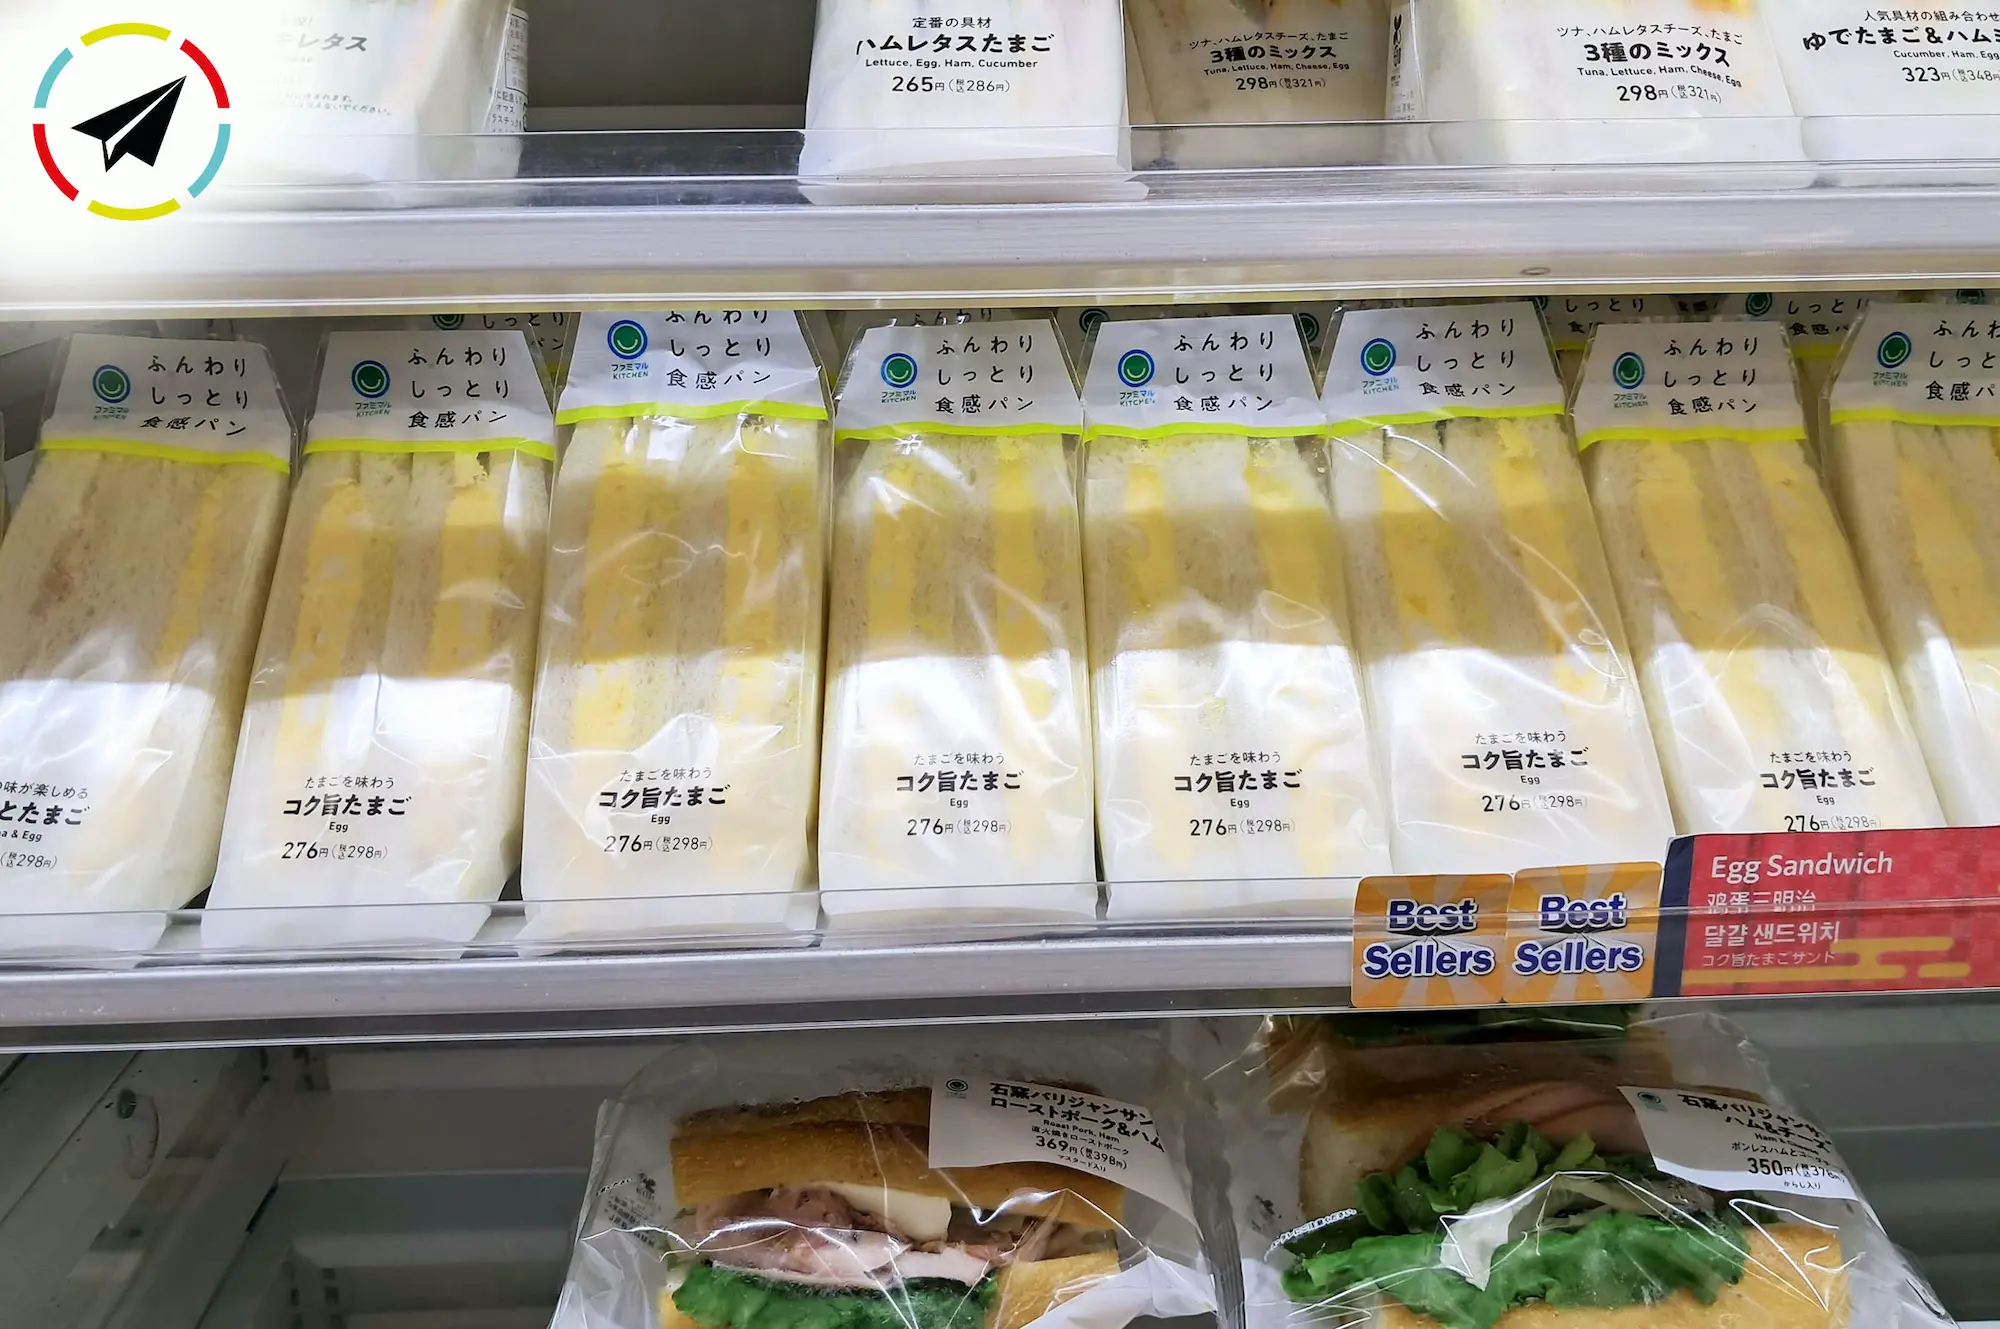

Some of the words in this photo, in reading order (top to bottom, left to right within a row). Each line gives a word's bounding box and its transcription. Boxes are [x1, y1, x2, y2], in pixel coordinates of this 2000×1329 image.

[912, 17, 992, 28] 定番の具材
[1189, 32, 1349, 50] ツナ、ハムレタスチーズ、たまご
[1556, 23, 1744, 45] ツナ、ハムレタスチーズ、たまご
[855, 33, 1055, 55] ハムレタスたまご
[865, 59, 912, 68] Lettuce,
[916, 59, 941, 69] Egg,
[945, 59, 974, 68] Ham,
[978, 59, 1038, 68] Cucumber
[1211, 45, 1337, 64] 3種のミックス
[1583, 41, 1730, 68] 3種のミックス
[1893, 50, 1950, 59] Cucumber,
[1952, 50, 1978, 59] Ham,
[1204, 68, 1230, 76] Tuna,
[1231, 63, 1268, 72] Lettuce,
[1270, 62, 1294, 71] Ham,
[1333, 62, 1350, 70] Egg
[1577, 67, 1608, 77] Tuna,
[1610, 67, 1656, 76] Lettuce,
[1659, 65, 1688, 74] Ham,
[1690, 65, 1724, 83] Cheese,
[1725, 75, 1742, 88] Egg
[1566, 298, 1644, 313] しっとり
[665, 310, 769, 324] ふんわり
[1416, 318, 1514, 340] ふんわり
[670, 337, 771, 357] しっとり
[936, 335, 1033, 355] ふんわり
[1173, 331, 1274, 351] ふんわり
[1664, 337, 1758, 356] ふんわり
[408, 347, 506, 366] ふんわり
[1417, 351, 1514, 372] しっとり
[1929, 351, 1996, 369] しっと
[148, 356, 245, 377] ふんわり
[611, 363, 649, 371] ファミマル
[613, 371, 649, 381] KITCHEN
[938, 365, 1033, 385] しっとり
[1176, 363, 1274, 384] しっとり
[666, 368, 771, 389] 食感パン
[1664, 369, 1756, 387] しっとり
[151, 387, 248, 409] しっとり
[412, 380, 509, 399] しっとり
[1119, 390, 1155, 399] ファミマル
[1419, 382, 1516, 398] 食感パン
[1926, 380, 1995, 401] 食感パ
[881, 396, 917, 404] KITCHEN
[935, 394, 1034, 414] 食感パン
[1173, 395, 1273, 412] 食感パン
[1668, 396, 1757, 415] 食感パン
[140, 416, 247, 436] 食感パン
[408, 411, 507, 428] 食感パン
[1475, 730, 1566, 745] たまごを味わう
[913, 752, 1005, 766] たまごを味わう
[1190, 751, 1281, 766] たまごを味わう
[1461, 746, 1589, 771] コク旨たまご
[1770, 750, 1852, 764] たまごを味わう
[304, 775, 395, 789] たまごを味わう
[619, 767, 712, 782] たまごを味わう
[896, 770, 1025, 792] コク旨たまご
[1174, 768, 1303, 793] コク旨たまご
[1520, 775, 1541, 785] Egg
[1760, 766, 1876, 790] コク旨たまご
[283, 793, 412, 816] コク旨たまご
[599, 784, 731, 809] コク旨たまご
[950, 798, 969, 808] Egg
[1230, 798, 1250, 809] Egg
[1816, 795, 1836, 805] Egg
[0, 800, 91, 825] とたまご
[651, 814, 671, 825] Egg
[11, 829, 18, 838] &
[22, 830, 42, 842] Egg
[329, 821, 349, 833] Egg
[1711, 855, 1762, 884] Egg
[1766, 851, 1893, 877] Sandwich
[1389, 899, 1476, 929] Best
[1540, 894, 1626, 927] Best
[1705, 923, 1748, 949] 달걀
[1753, 920, 1841, 946] 샌드위치
[1364, 945, 1493, 976] Sellers
[1515, 941, 1641, 973] Sellers
[1702, 950, 1836, 968] コク旨たまごサンド
[1043, 1119, 1070, 1130] Roast
[1099, 1132, 1120, 1143] Ham
